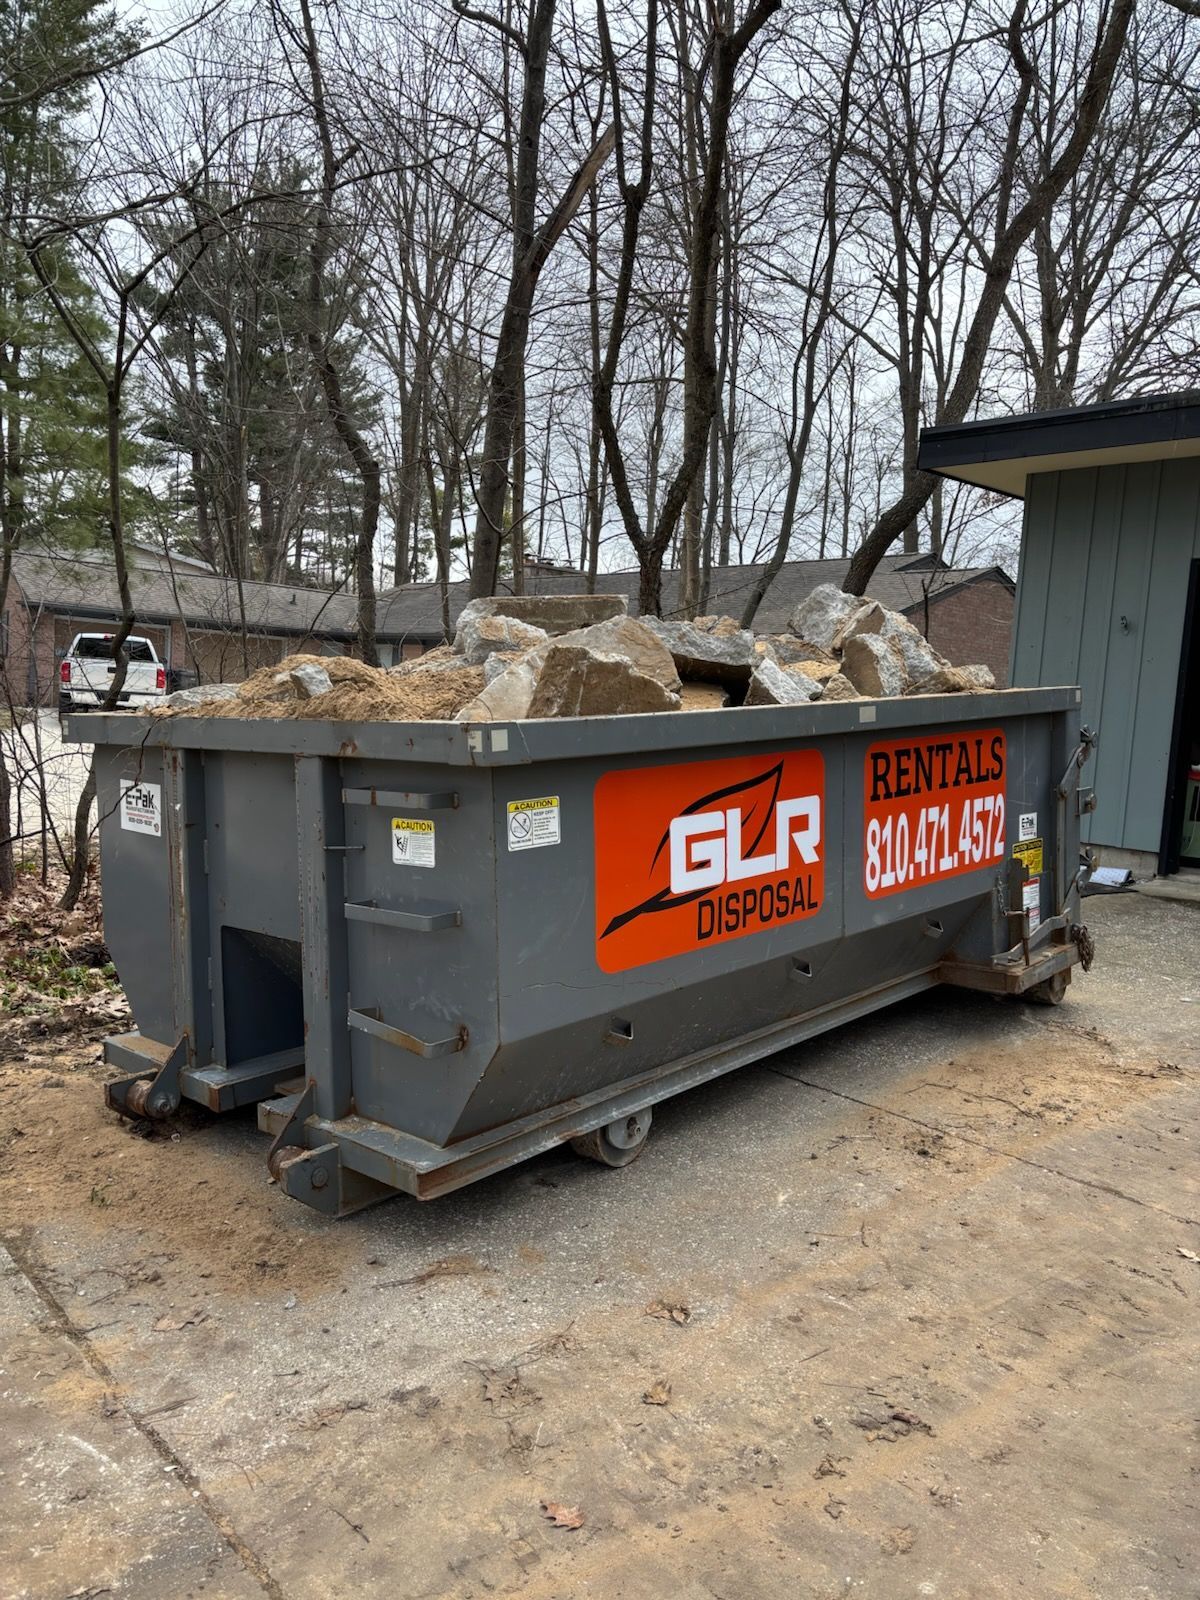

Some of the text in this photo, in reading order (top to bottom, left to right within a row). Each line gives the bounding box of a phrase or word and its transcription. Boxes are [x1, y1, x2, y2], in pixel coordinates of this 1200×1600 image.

[870, 736, 1004, 802] RENTALS
[400, 821, 432, 831] CAUTION
[519, 800, 553, 810] CAUTION
[670, 794, 821, 895] GLR
[865, 793, 1005, 892] 810.471.4572
[697, 874, 818, 941] DISPOSAL
